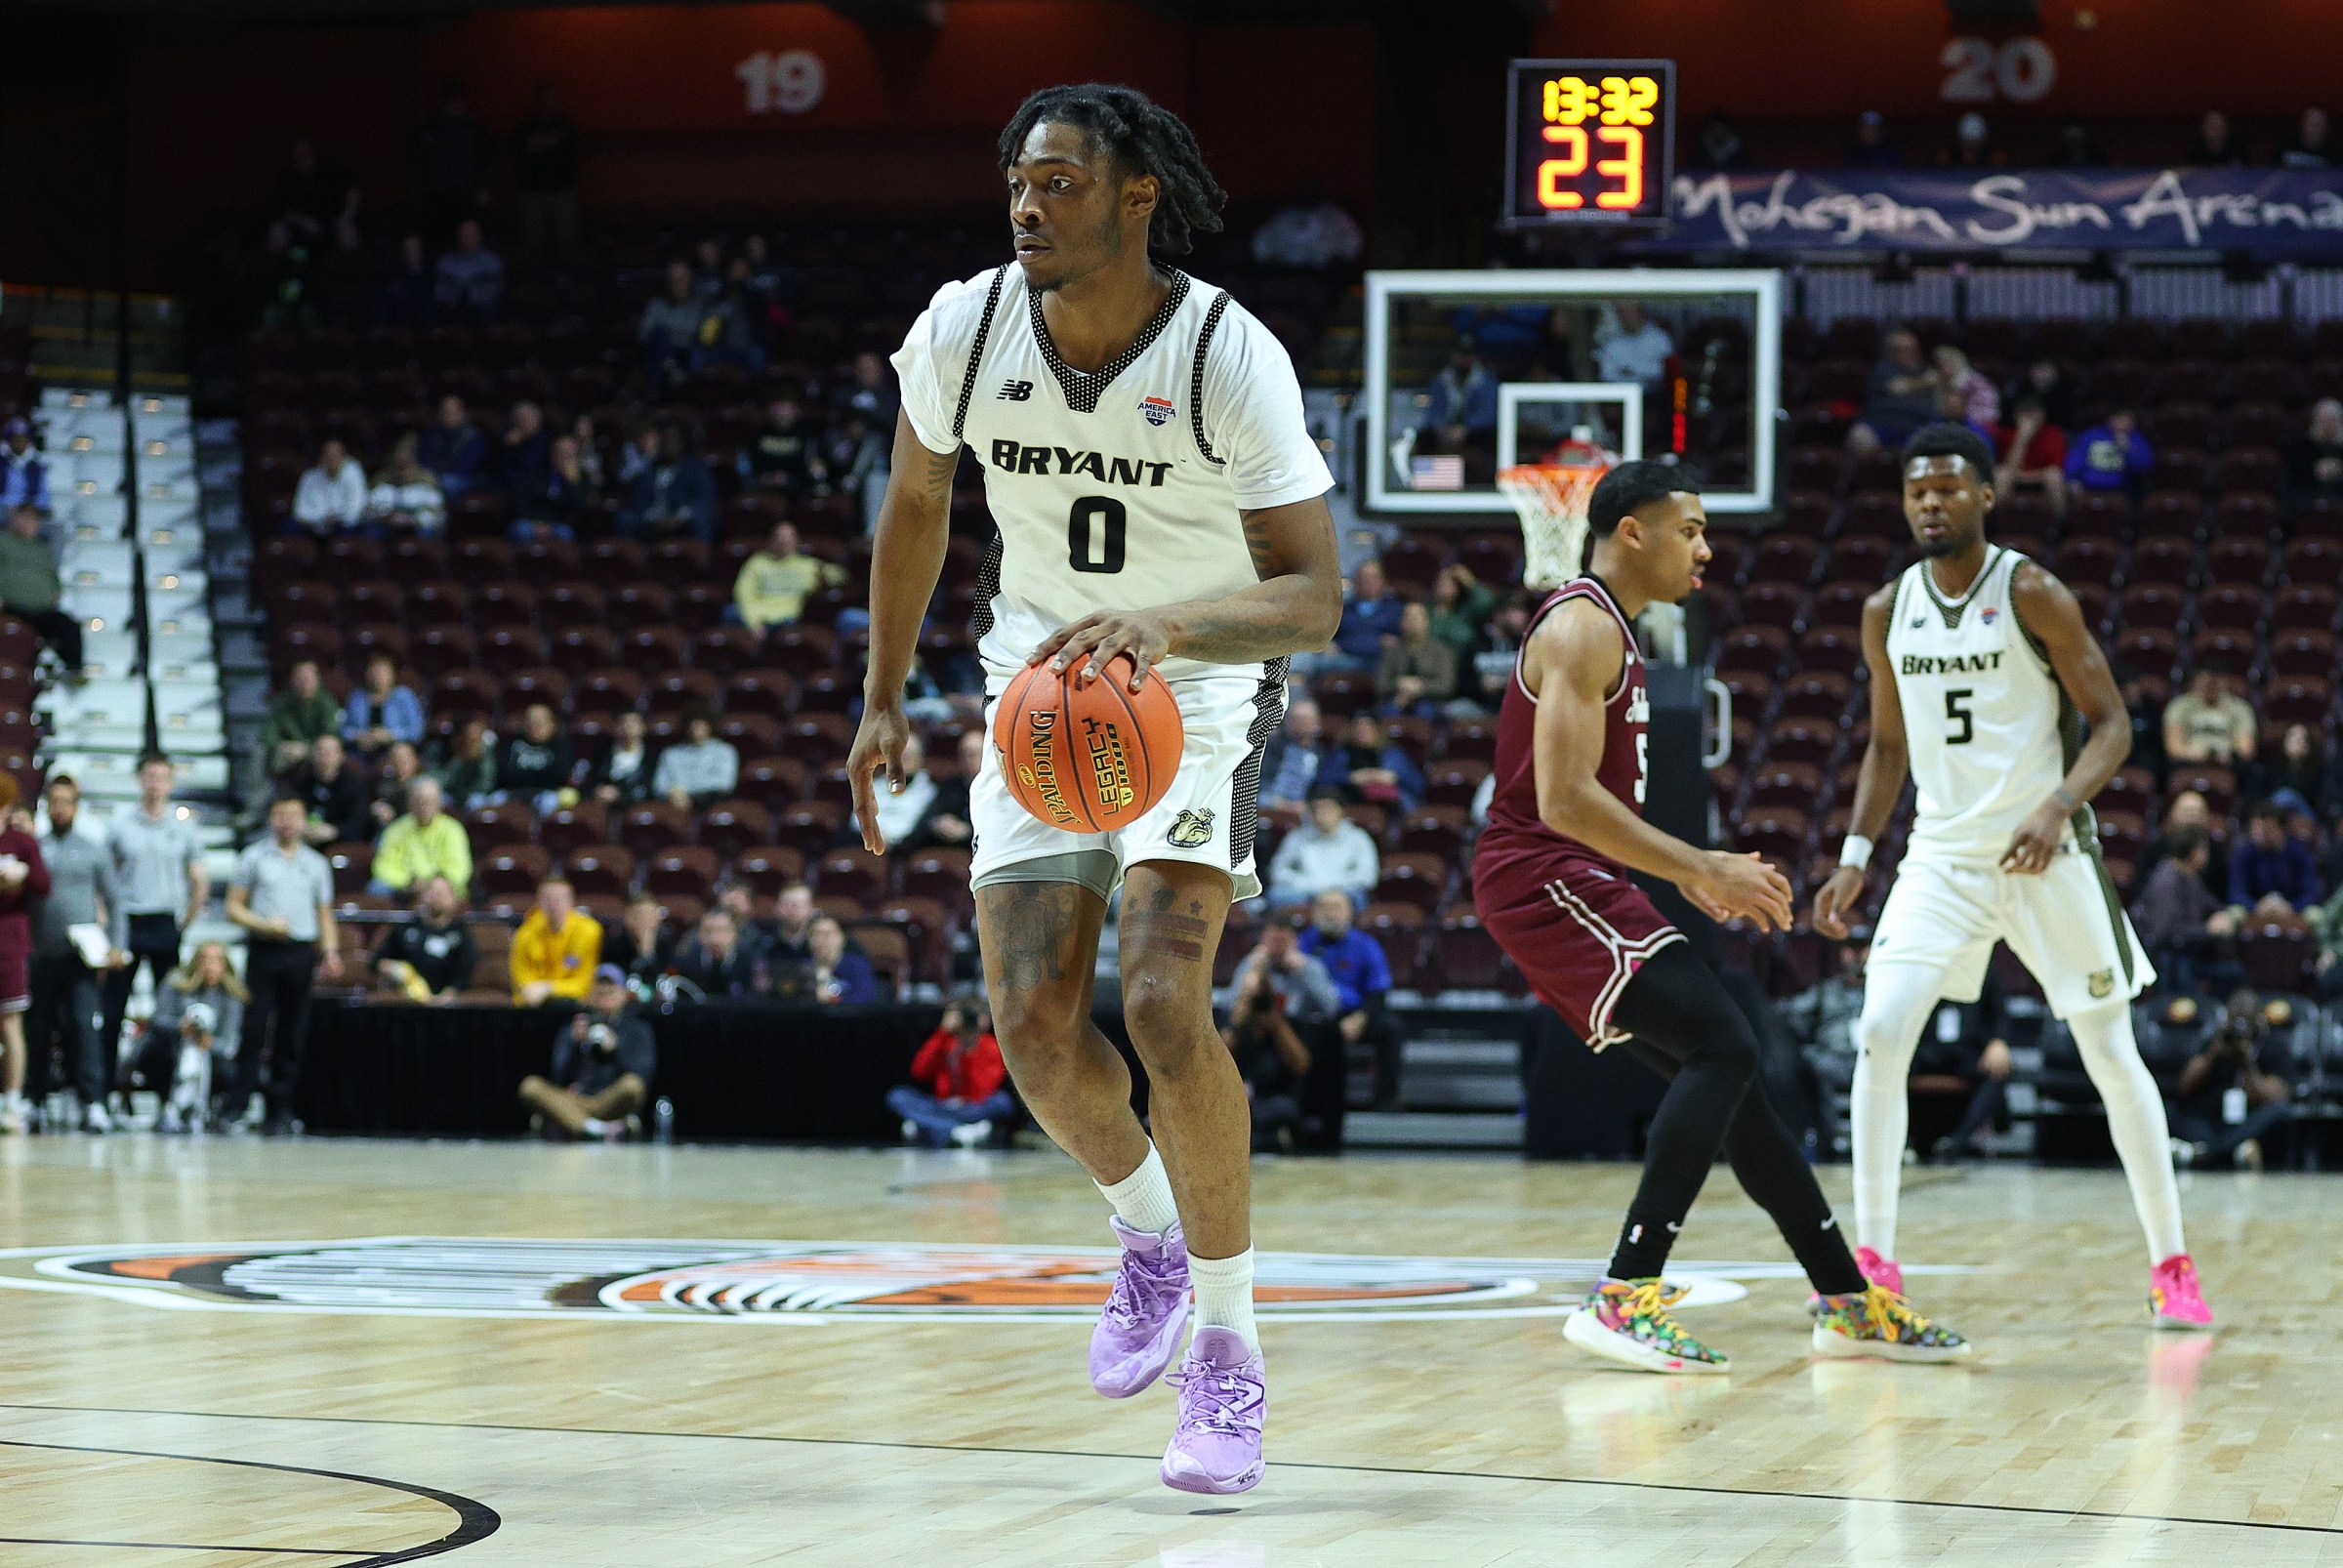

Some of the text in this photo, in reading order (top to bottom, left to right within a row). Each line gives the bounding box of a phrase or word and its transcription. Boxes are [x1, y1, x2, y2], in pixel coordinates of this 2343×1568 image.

[734, 49, 826, 113] 19
[1542, 76, 1658, 126] 13:32
[1940, 37, 2055, 101] 20
[1538, 126, 1644, 209] 23
[1671, 170, 2343, 249] Mohegan Sun Arena
[1137, 402, 1176, 418] AMERICA
[1145, 410, 1168, 420] EAST
[992, 438, 1174, 487] BRYANT
[1069, 495, 1127, 574] 0
[1902, 650, 2004, 675] BRYANT
[1946, 688, 1973, 745] 5
[1030, 710, 1084, 825] SPALDING
[1081, 717, 1121, 815] LEGACY
[1105, 722, 1130, 786] 1000
